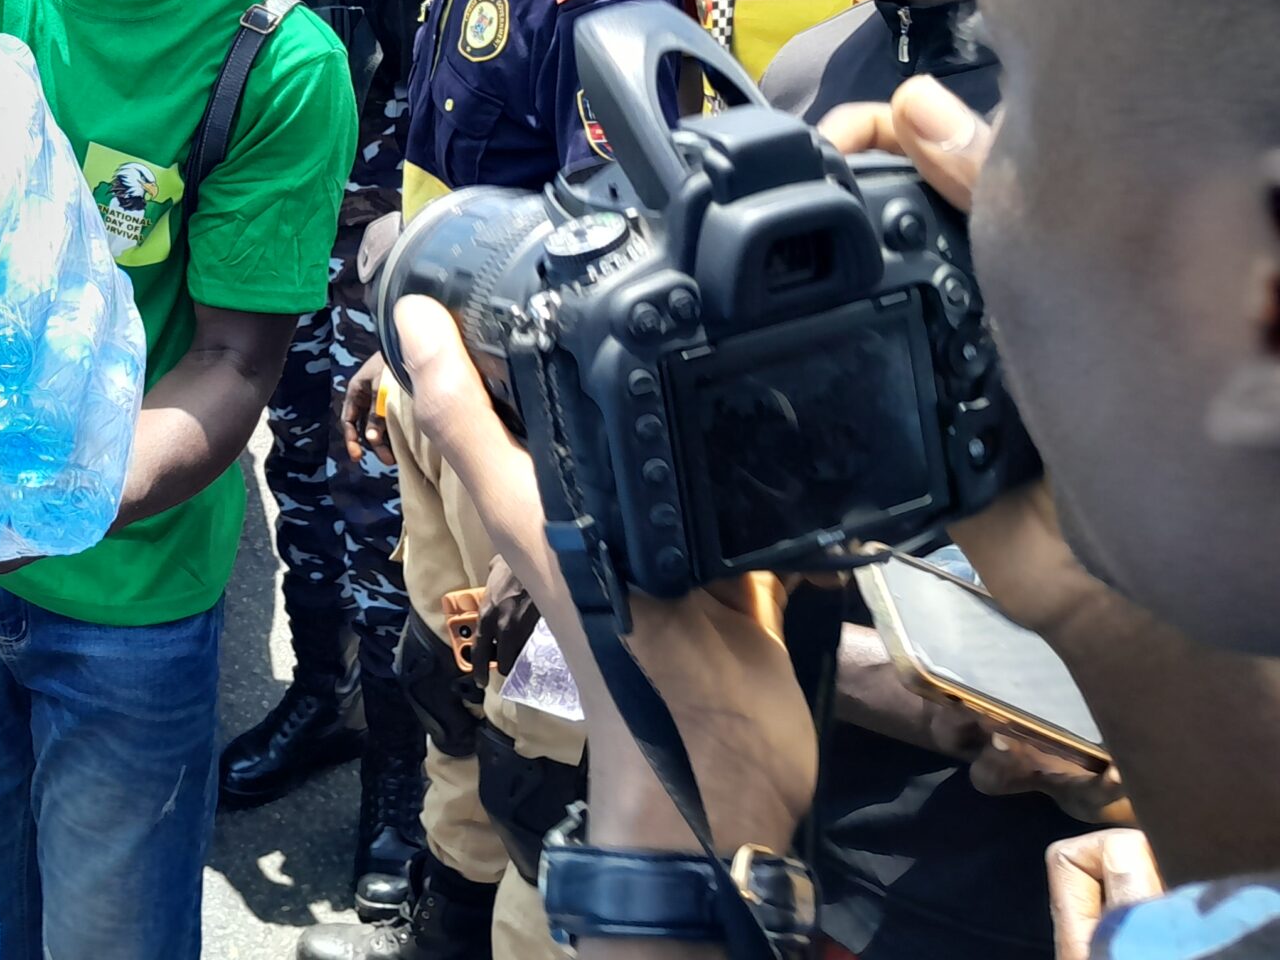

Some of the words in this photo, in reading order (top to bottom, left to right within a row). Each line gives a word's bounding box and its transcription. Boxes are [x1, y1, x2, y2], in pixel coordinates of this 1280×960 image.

[105, 215, 124, 228] DAY
[126, 222, 141, 233] OF
[105, 223, 145, 242] URVIVAL
